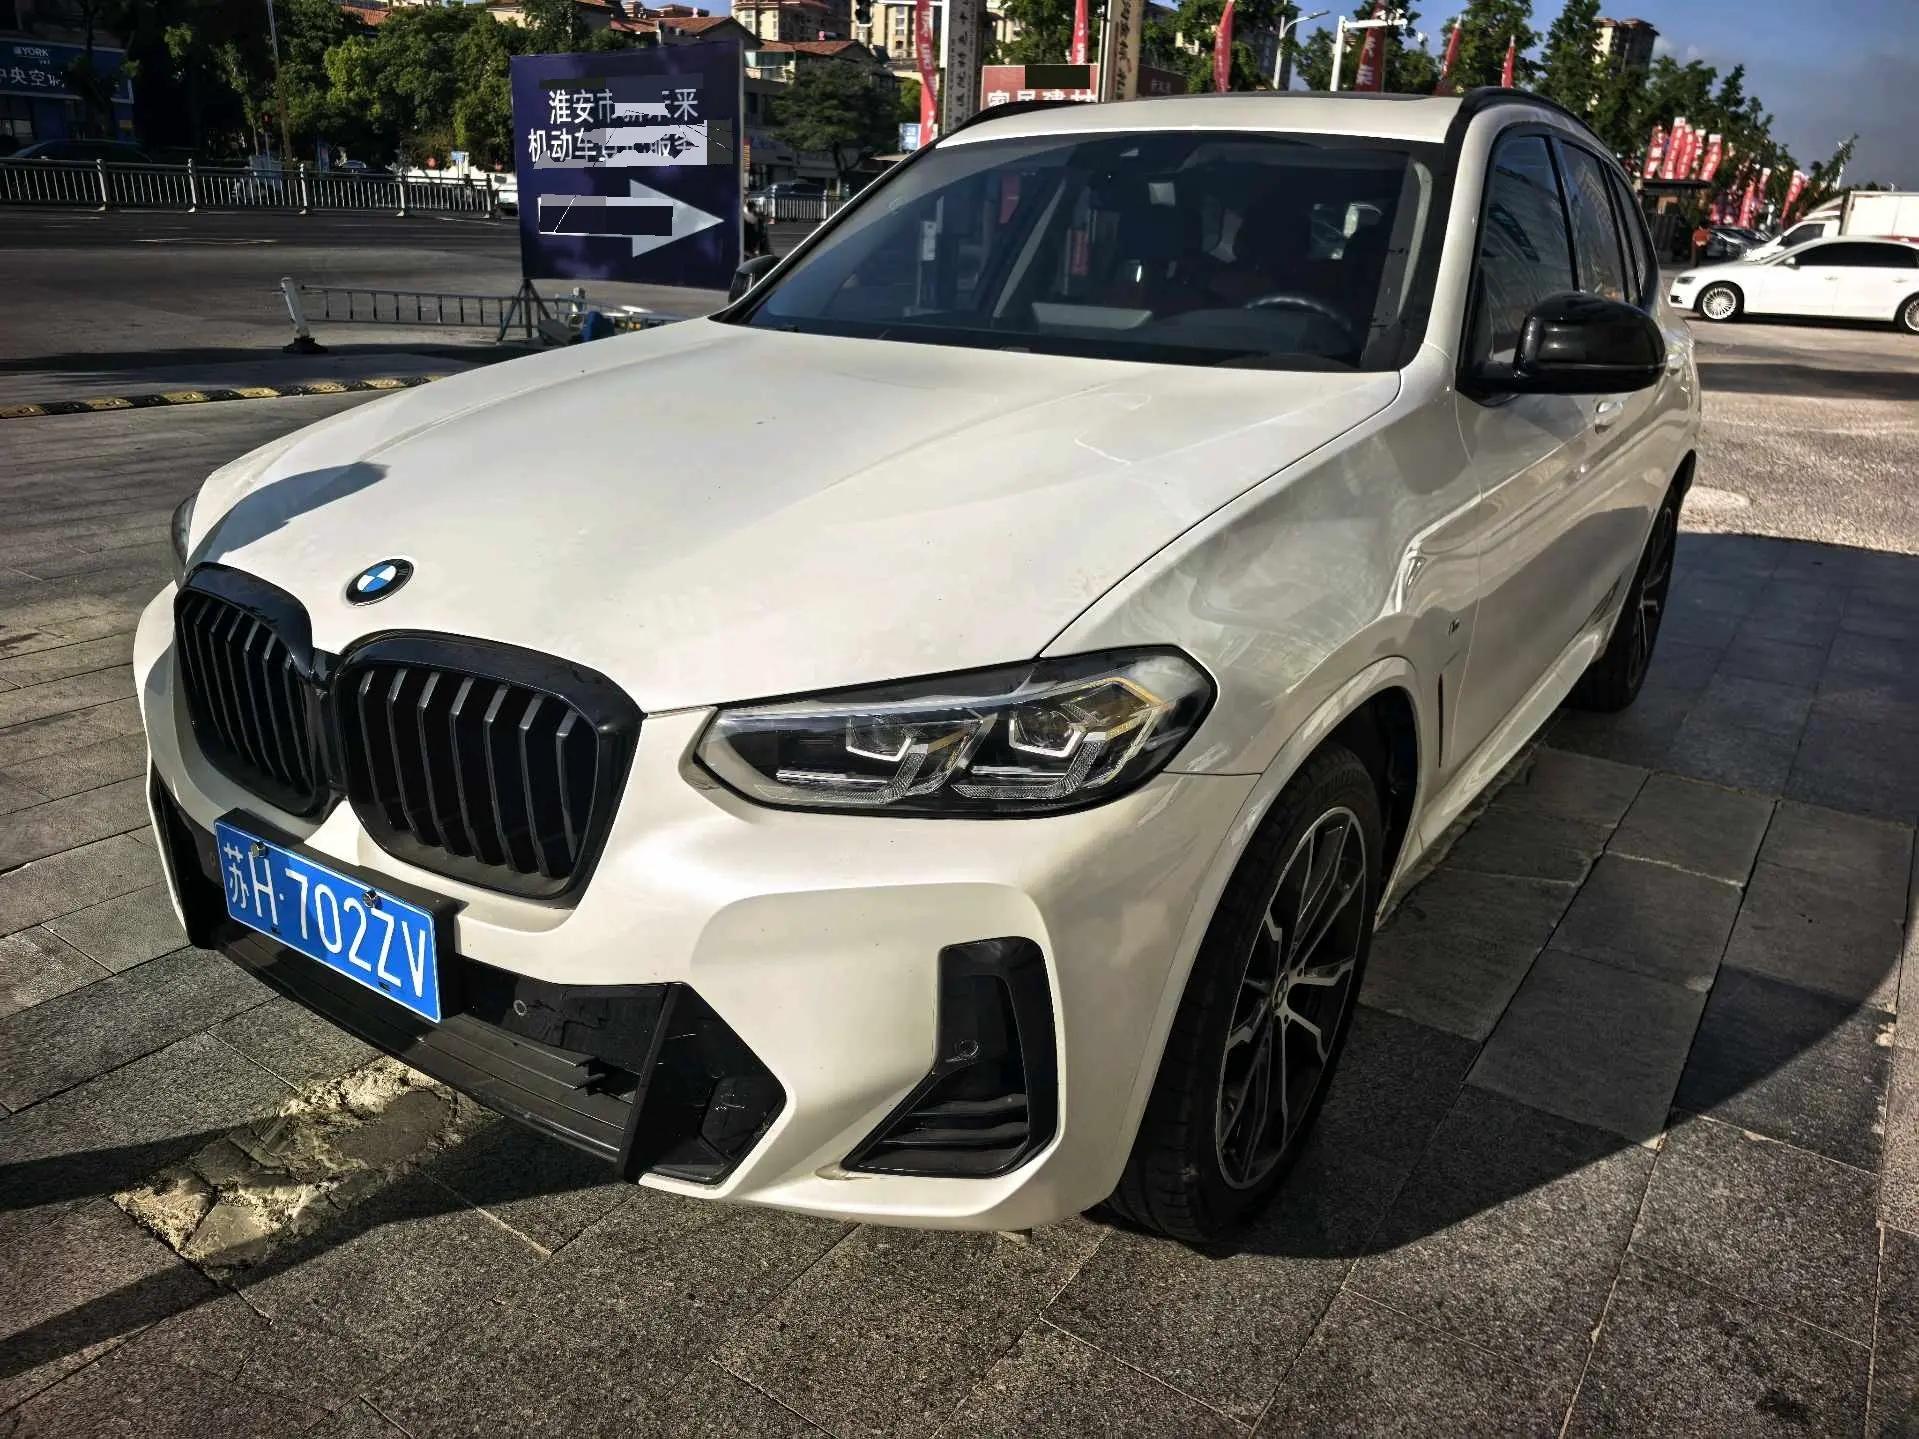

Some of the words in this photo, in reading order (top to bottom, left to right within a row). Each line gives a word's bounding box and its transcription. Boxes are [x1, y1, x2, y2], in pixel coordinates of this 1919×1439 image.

[22, 47, 49, 57] YORK
[548, 88, 699, 125] 淮安市来
